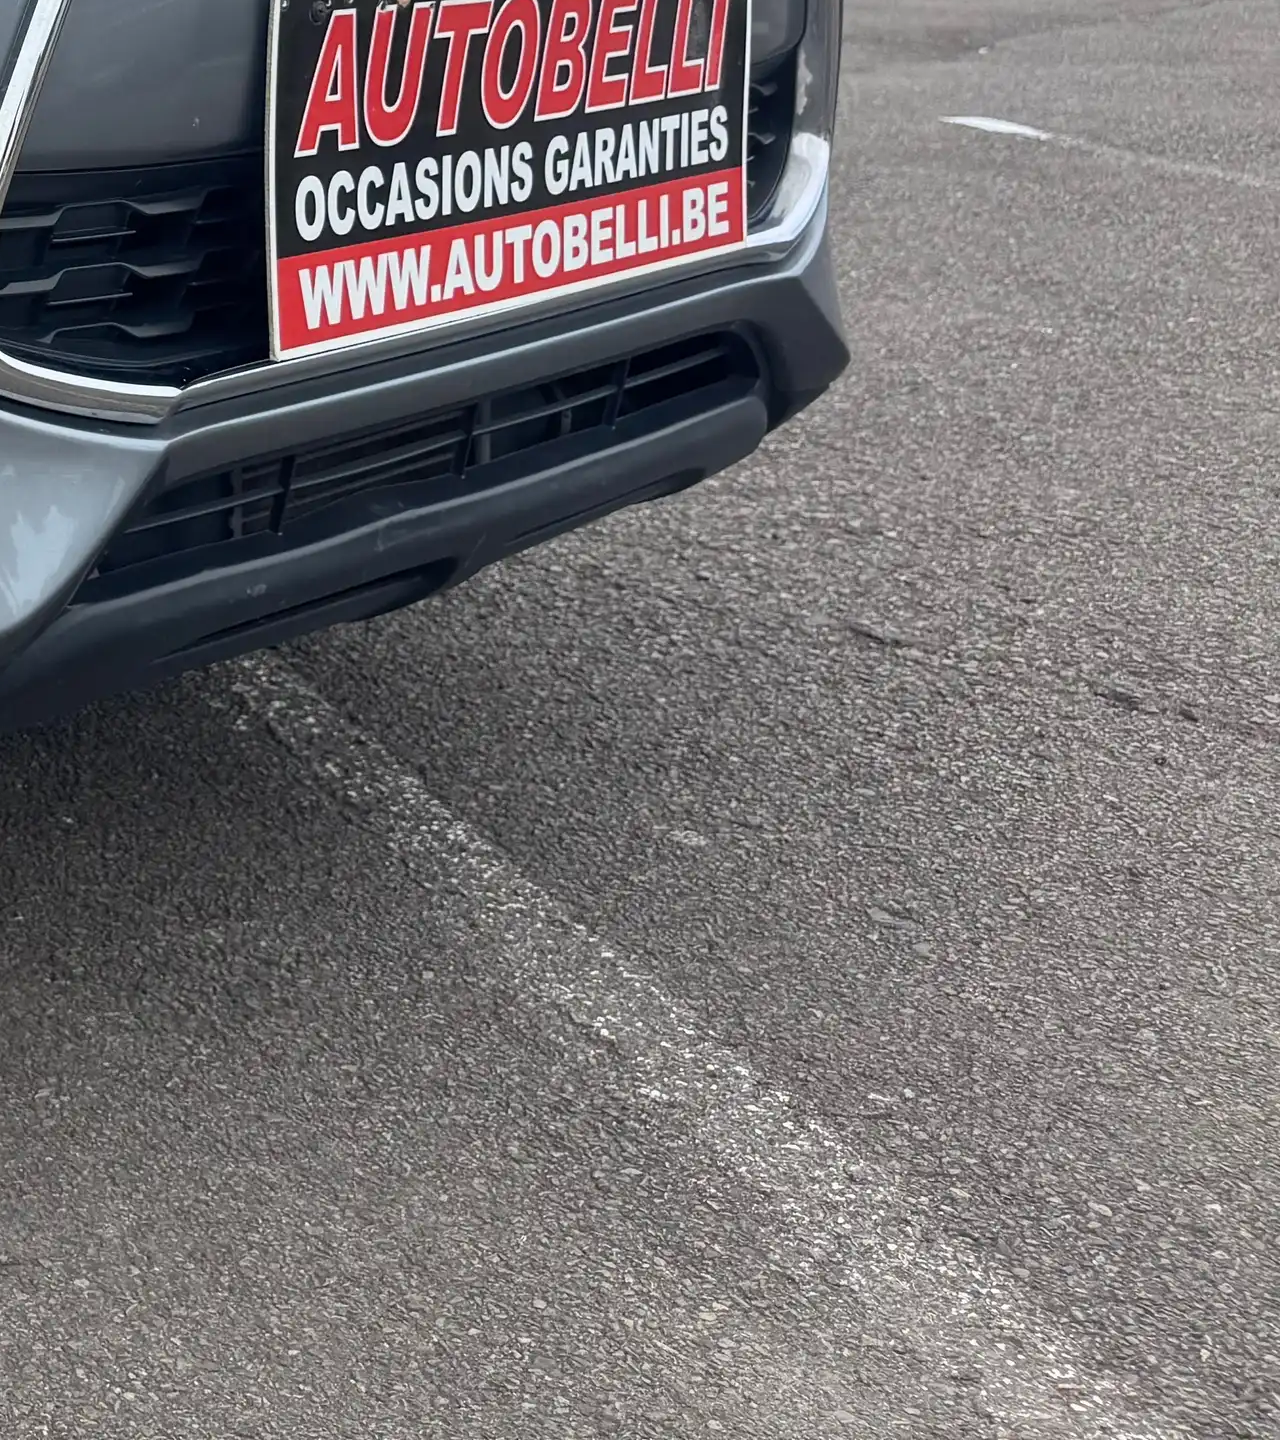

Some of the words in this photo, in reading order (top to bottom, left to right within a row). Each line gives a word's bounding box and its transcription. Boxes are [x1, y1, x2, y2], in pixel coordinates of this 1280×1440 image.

[295, 140, 533, 242] OCCASIONS
[544, 105, 729, 195] GARANTIES
[298, 182, 730, 331] WWW.AUTOBELLI.BE
